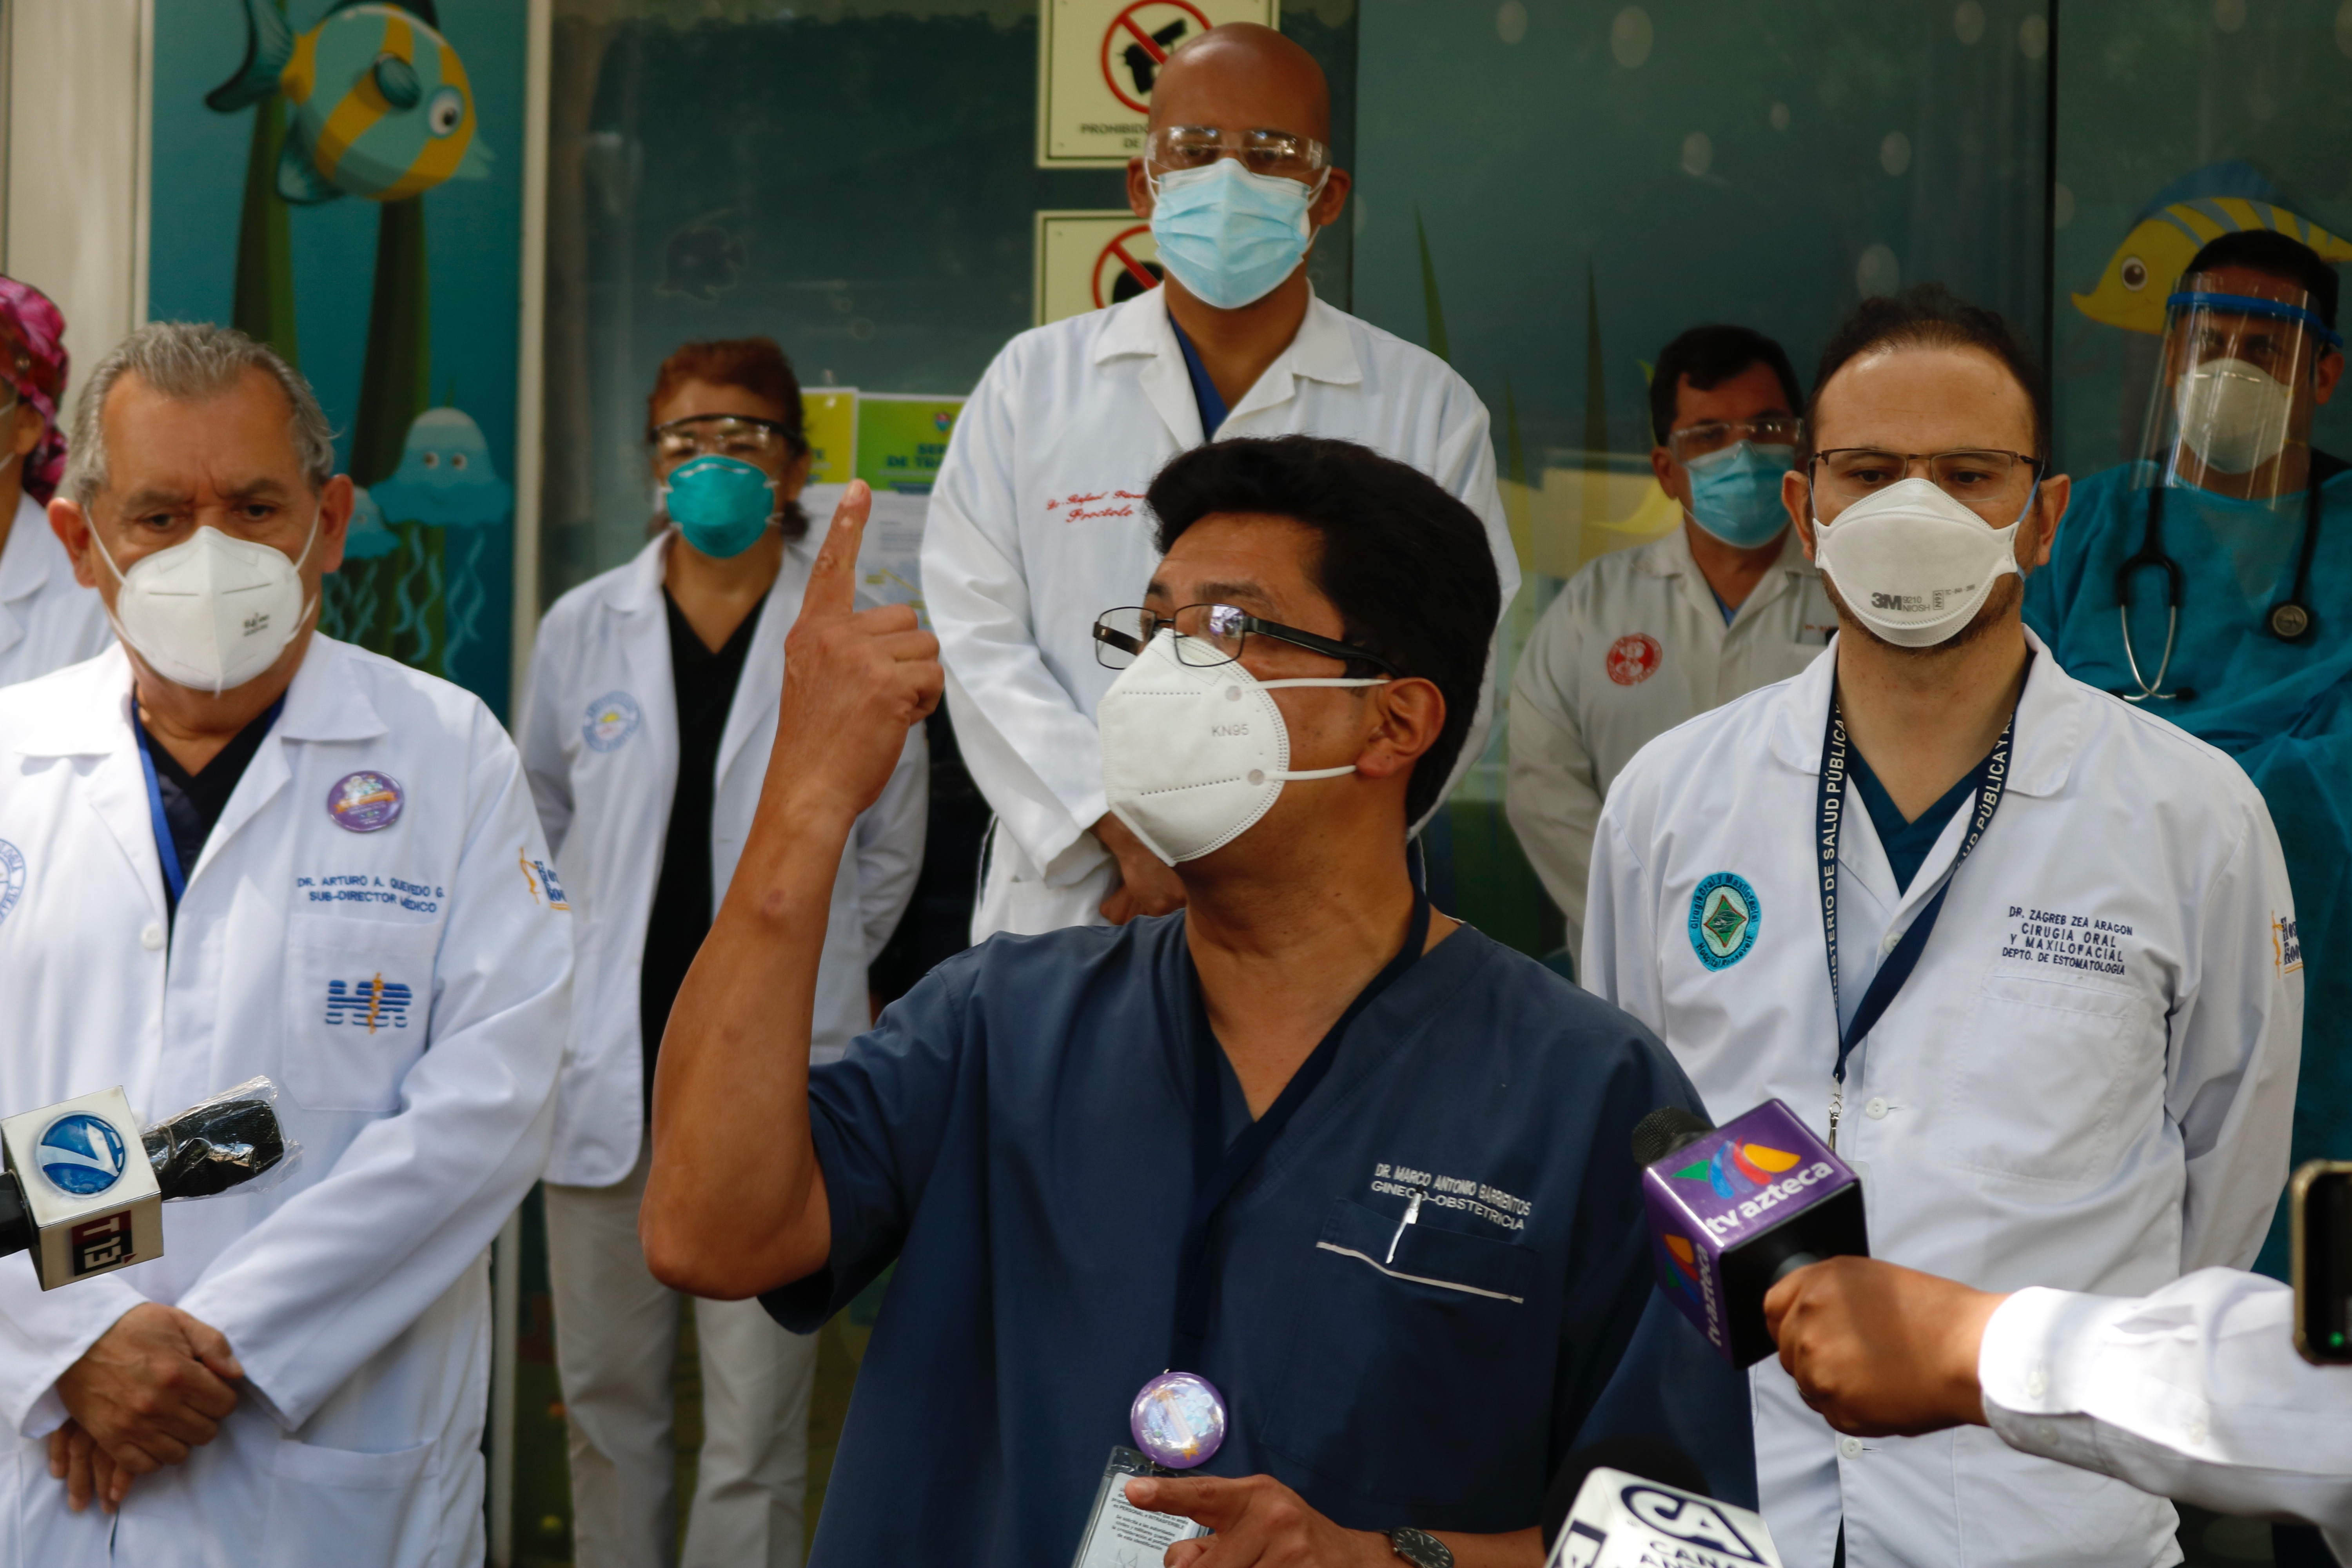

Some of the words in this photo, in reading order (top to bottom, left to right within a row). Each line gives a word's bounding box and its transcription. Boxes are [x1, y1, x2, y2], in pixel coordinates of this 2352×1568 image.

[1080, 123, 1148, 134] PROHIBID
[1871, 592, 1901, 610] 3M
[1211, 724, 1249, 736] KN95
[1825, 720, 1846, 793] PÚBLICA
[1977, 751, 2007, 830] PÚBLICA
[1823, 799, 1839, 859] SALUD
[298, 877, 315, 887] DR.
[322, 875, 368, 886] ARTURO
[374, 876, 385, 887] A.
[436, 886, 445, 898] G.
[1824, 864, 1835, 891] DE
[309, 891, 397, 903] SUB-DIRECTOR
[2009, 906, 2024, 918] DR.
[2029, 909, 2066, 925] ZAGREB
[2071, 915, 2088, 927] ZEA
[2094, 919, 2133, 936] ARAGON
[2010, 933, 2017, 945] Y
[2025, 937, 2123, 962] MAXILOFACIAL
[2022, 922, 2074, 941] CIRUGIA
[2084, 931, 2116, 948] ORAL
[2002, 947, 2033, 961] DEPTO.
[2038, 952, 2050, 963] DE
[2053, 954, 2125, 975] ESTOMATOLOGIA
[1374, 1163, 1391, 1178] DR.
[1393, 1165, 1431, 1187] MARCO
[1433, 1174, 1477, 1196] ANTONIO
[1705, 1209, 1742, 1234] tv
[1739, 1161, 1834, 1219] azteca
[1120, 1506, 1143, 1517] PERSONAL
